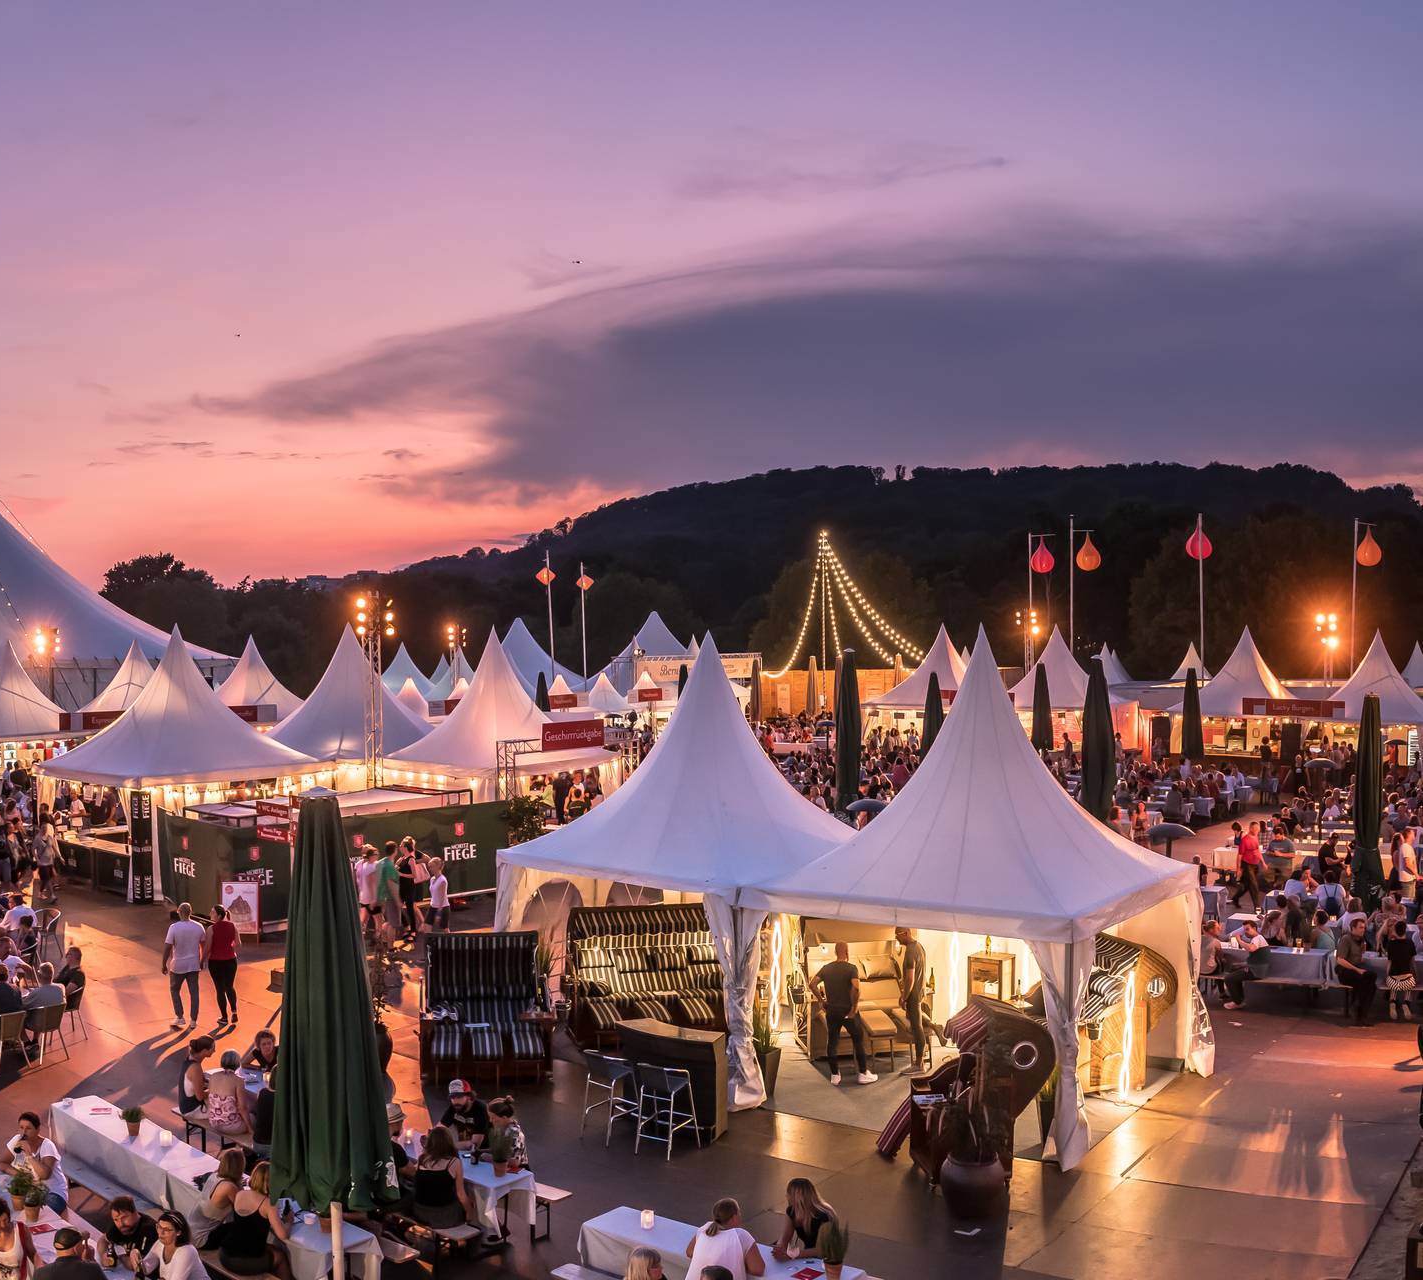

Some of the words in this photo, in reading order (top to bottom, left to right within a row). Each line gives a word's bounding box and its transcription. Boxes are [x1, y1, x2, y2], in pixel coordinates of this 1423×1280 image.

[1272, 703, 1290, 713] Lucky
[142, 794, 150, 819] FIEGE
[444, 843, 477, 861] FIEGE
[450, 842, 469, 850] MORITZ
[173, 857, 196, 878] FIEGE
[144, 875, 152, 899] FIEGE
